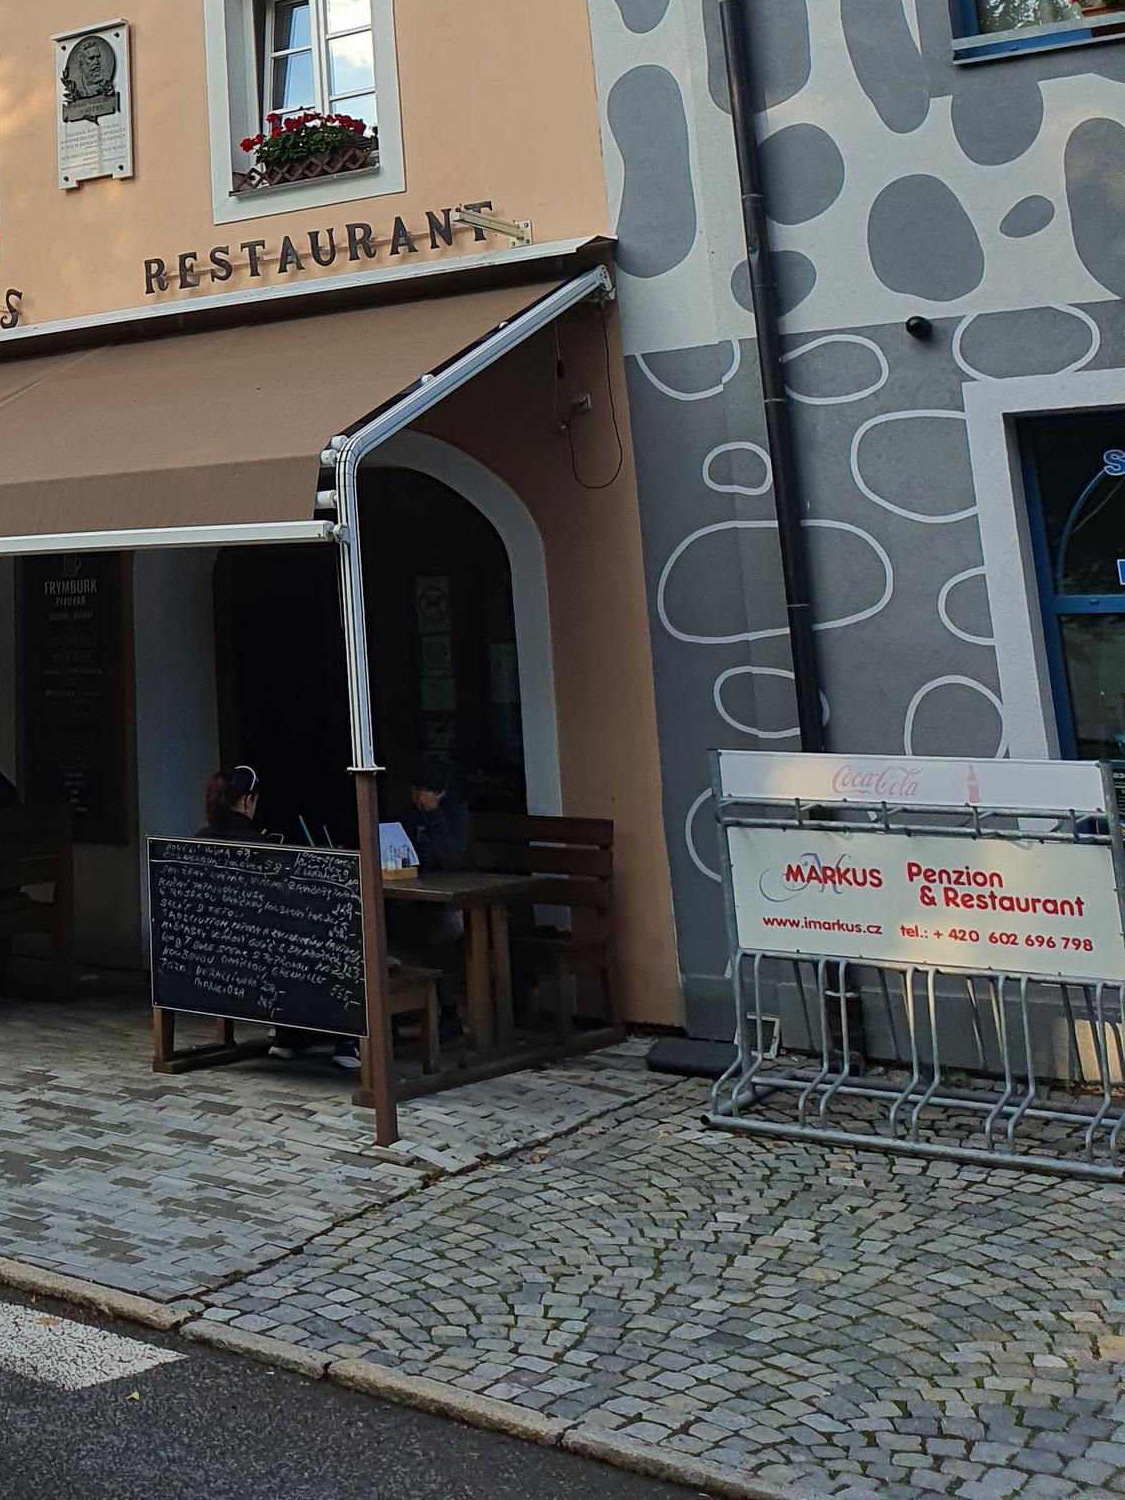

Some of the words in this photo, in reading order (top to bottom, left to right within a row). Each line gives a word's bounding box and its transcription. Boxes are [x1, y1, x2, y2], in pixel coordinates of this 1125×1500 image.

[144, 200, 493, 295] RESTAURANT
[43, 579, 98, 596] FRYMBURK
[785, 863, 883, 888] MARKUS
[907, 861, 1004, 889] Penzion
[920, 885, 938, 908] &
[943, 885, 1086, 918] Restaurant
[762, 915, 883, 937] www.imarkus.cz
[948, 926, 981, 944] 420
[988, 930, 1019, 947] 602
[1025, 932, 1057, 950] 696
[1060, 935, 1095, 954] 798
